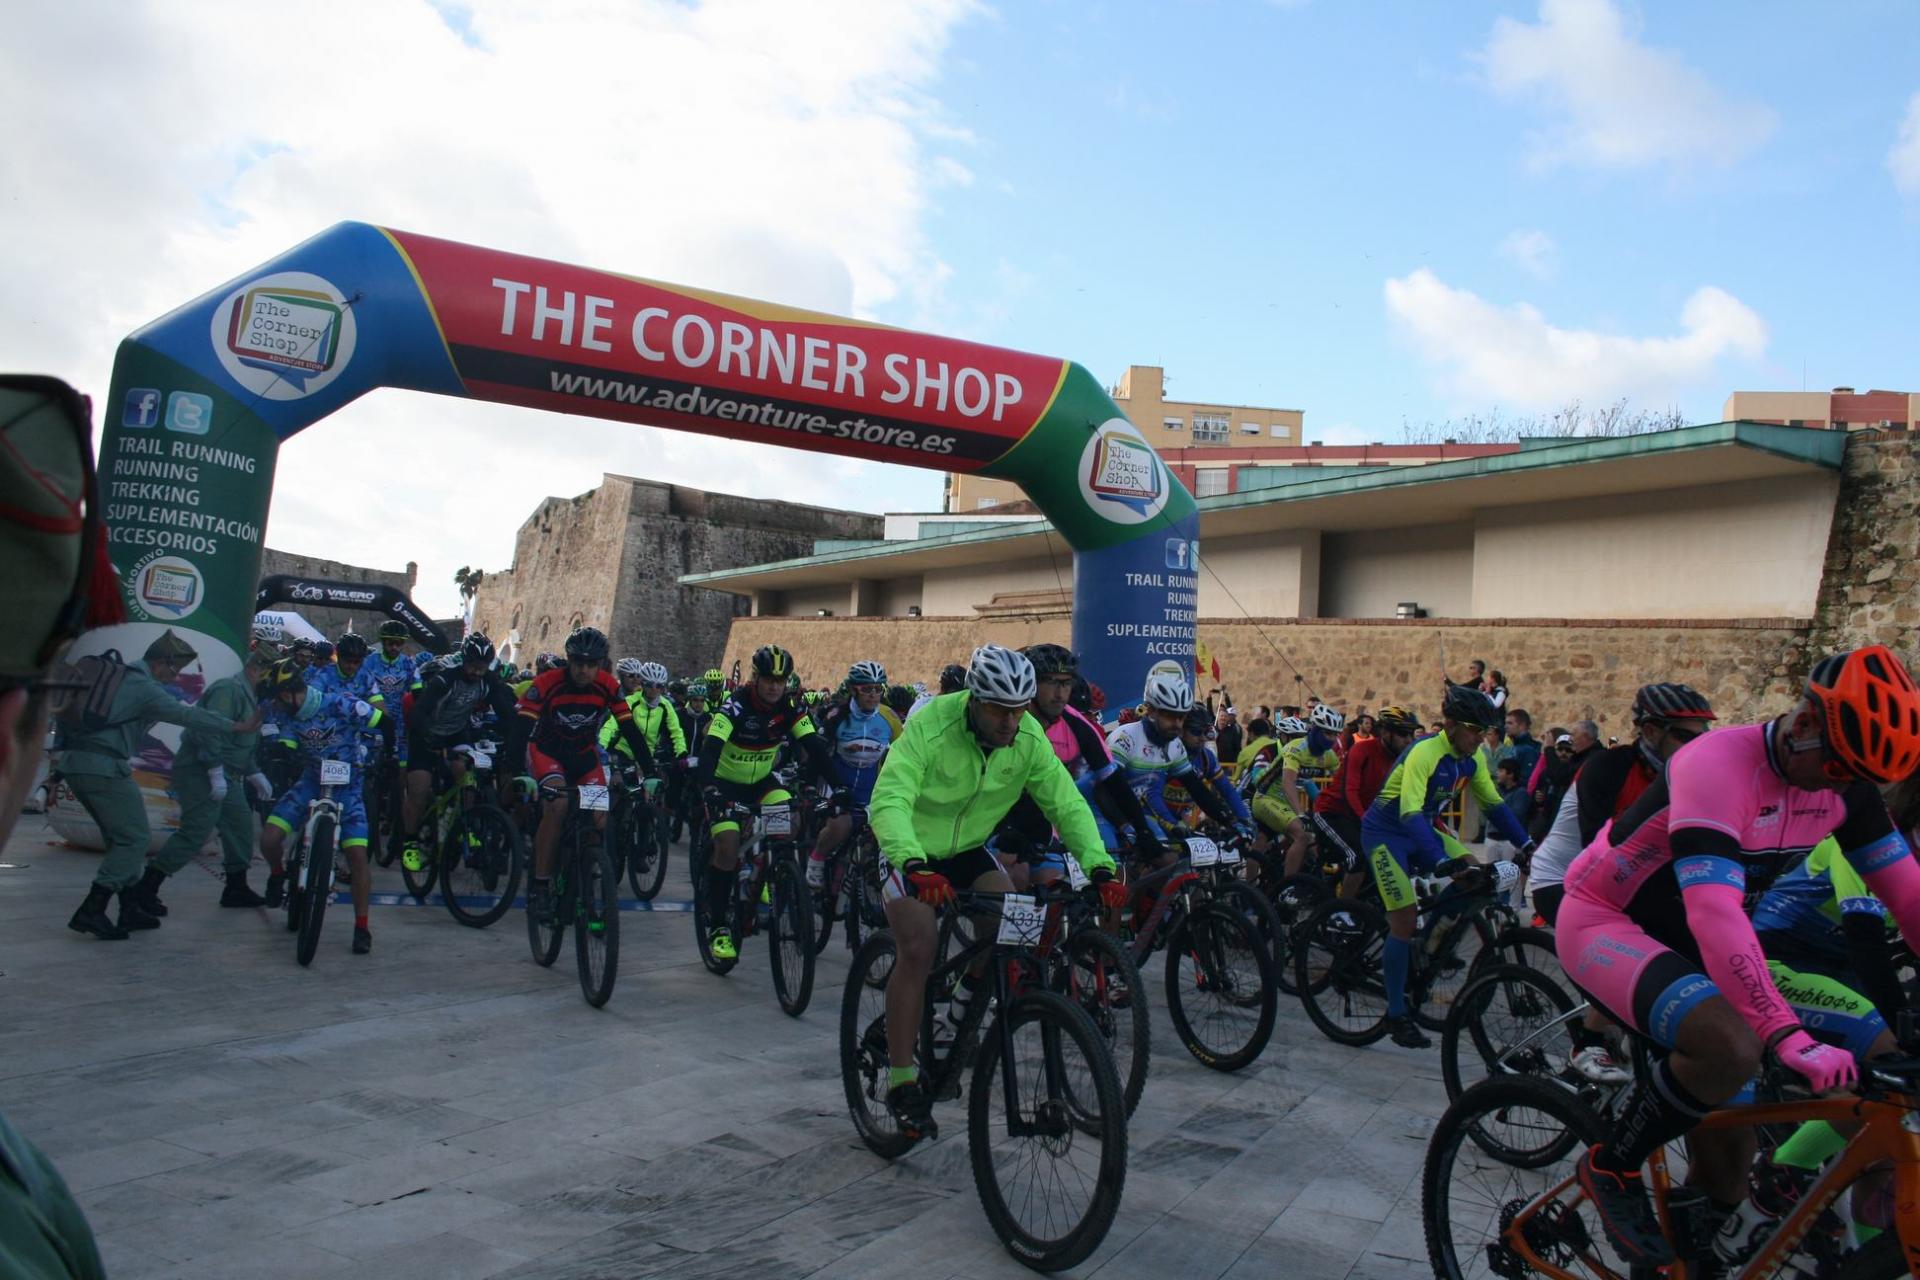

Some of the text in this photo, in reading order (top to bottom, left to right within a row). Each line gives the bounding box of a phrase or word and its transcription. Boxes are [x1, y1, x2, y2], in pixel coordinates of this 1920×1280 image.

[254, 301, 291, 318] The
[252, 317, 321, 341] Corner
[250, 331, 299, 356] Shop
[492, 277, 1023, 422] THE CORNER SHOP
[268, 354, 324, 371] ADVENTURE STORE
[550, 370, 957, 455] www.adventure-store.es
[118, 436, 257, 475] TRAIL RUNNING
[1109, 446, 1132, 460] The
[114, 459, 199, 483] RUNNING
[1107, 459, 1150, 475] Corner
[1105, 472, 1139, 488] Shop
[111, 481, 200, 506] TREKKING
[106, 503, 260, 544] SUPLEMENTACIÓN
[127, 548, 165, 621] CLUB DEPORTIVO
[1125, 573, 1198, 589] TRAIL RUNN
[327, 588, 375, 600] VALERO
[1167, 592, 1197, 606] RUNN
[401, 610, 436, 638] SCOTT
[1163, 608, 1197, 623] TREKK
[1106, 623, 1196, 640] SUPLEMENTAC
[1145, 642, 1195, 656] ACCESOR
